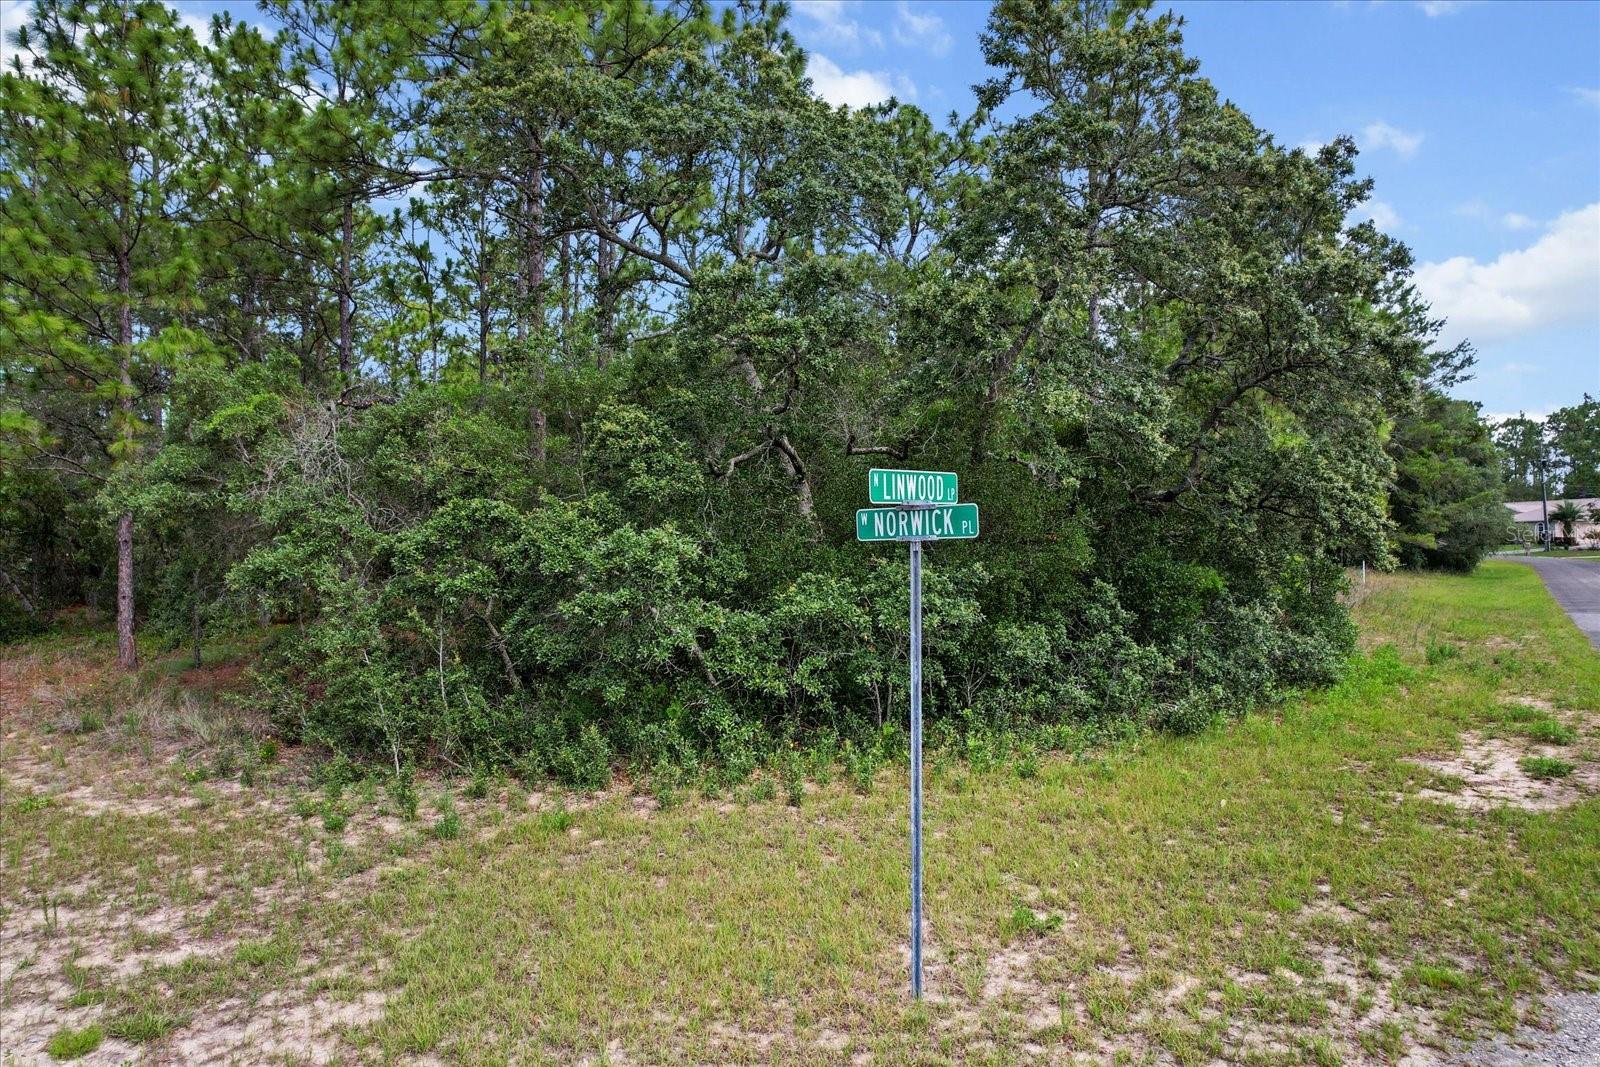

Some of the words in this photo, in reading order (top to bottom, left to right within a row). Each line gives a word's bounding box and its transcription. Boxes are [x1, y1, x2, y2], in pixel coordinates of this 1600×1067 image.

[873, 473, 879, 487] N
[883, 473, 944, 500] LINWOOD
[947, 487, 955, 500] LP
[861, 513, 868, 526] W
[874, 509, 954, 536] NORWICK
[962, 520, 974, 534] PL
